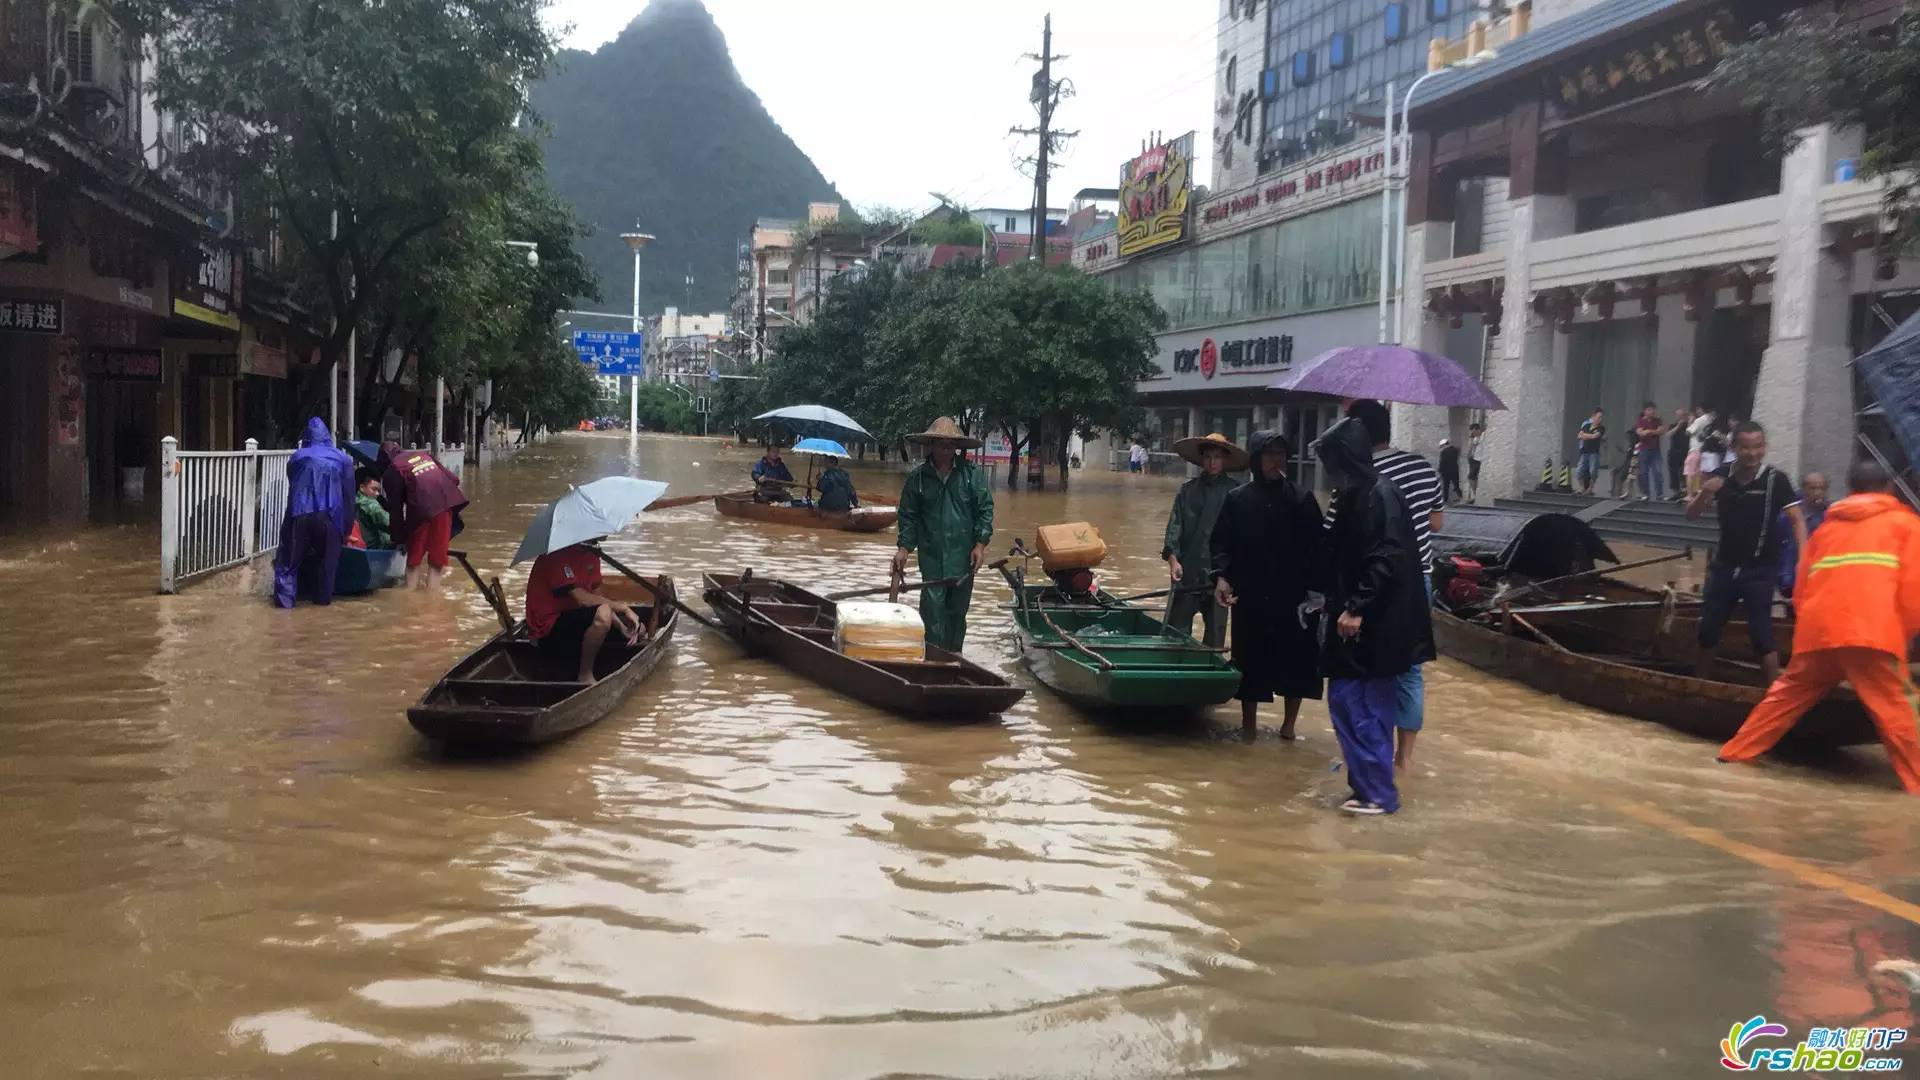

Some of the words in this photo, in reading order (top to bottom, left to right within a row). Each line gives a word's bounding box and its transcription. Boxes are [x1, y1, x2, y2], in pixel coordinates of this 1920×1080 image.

[1221, 334, 1293, 369] 中国工商银行
